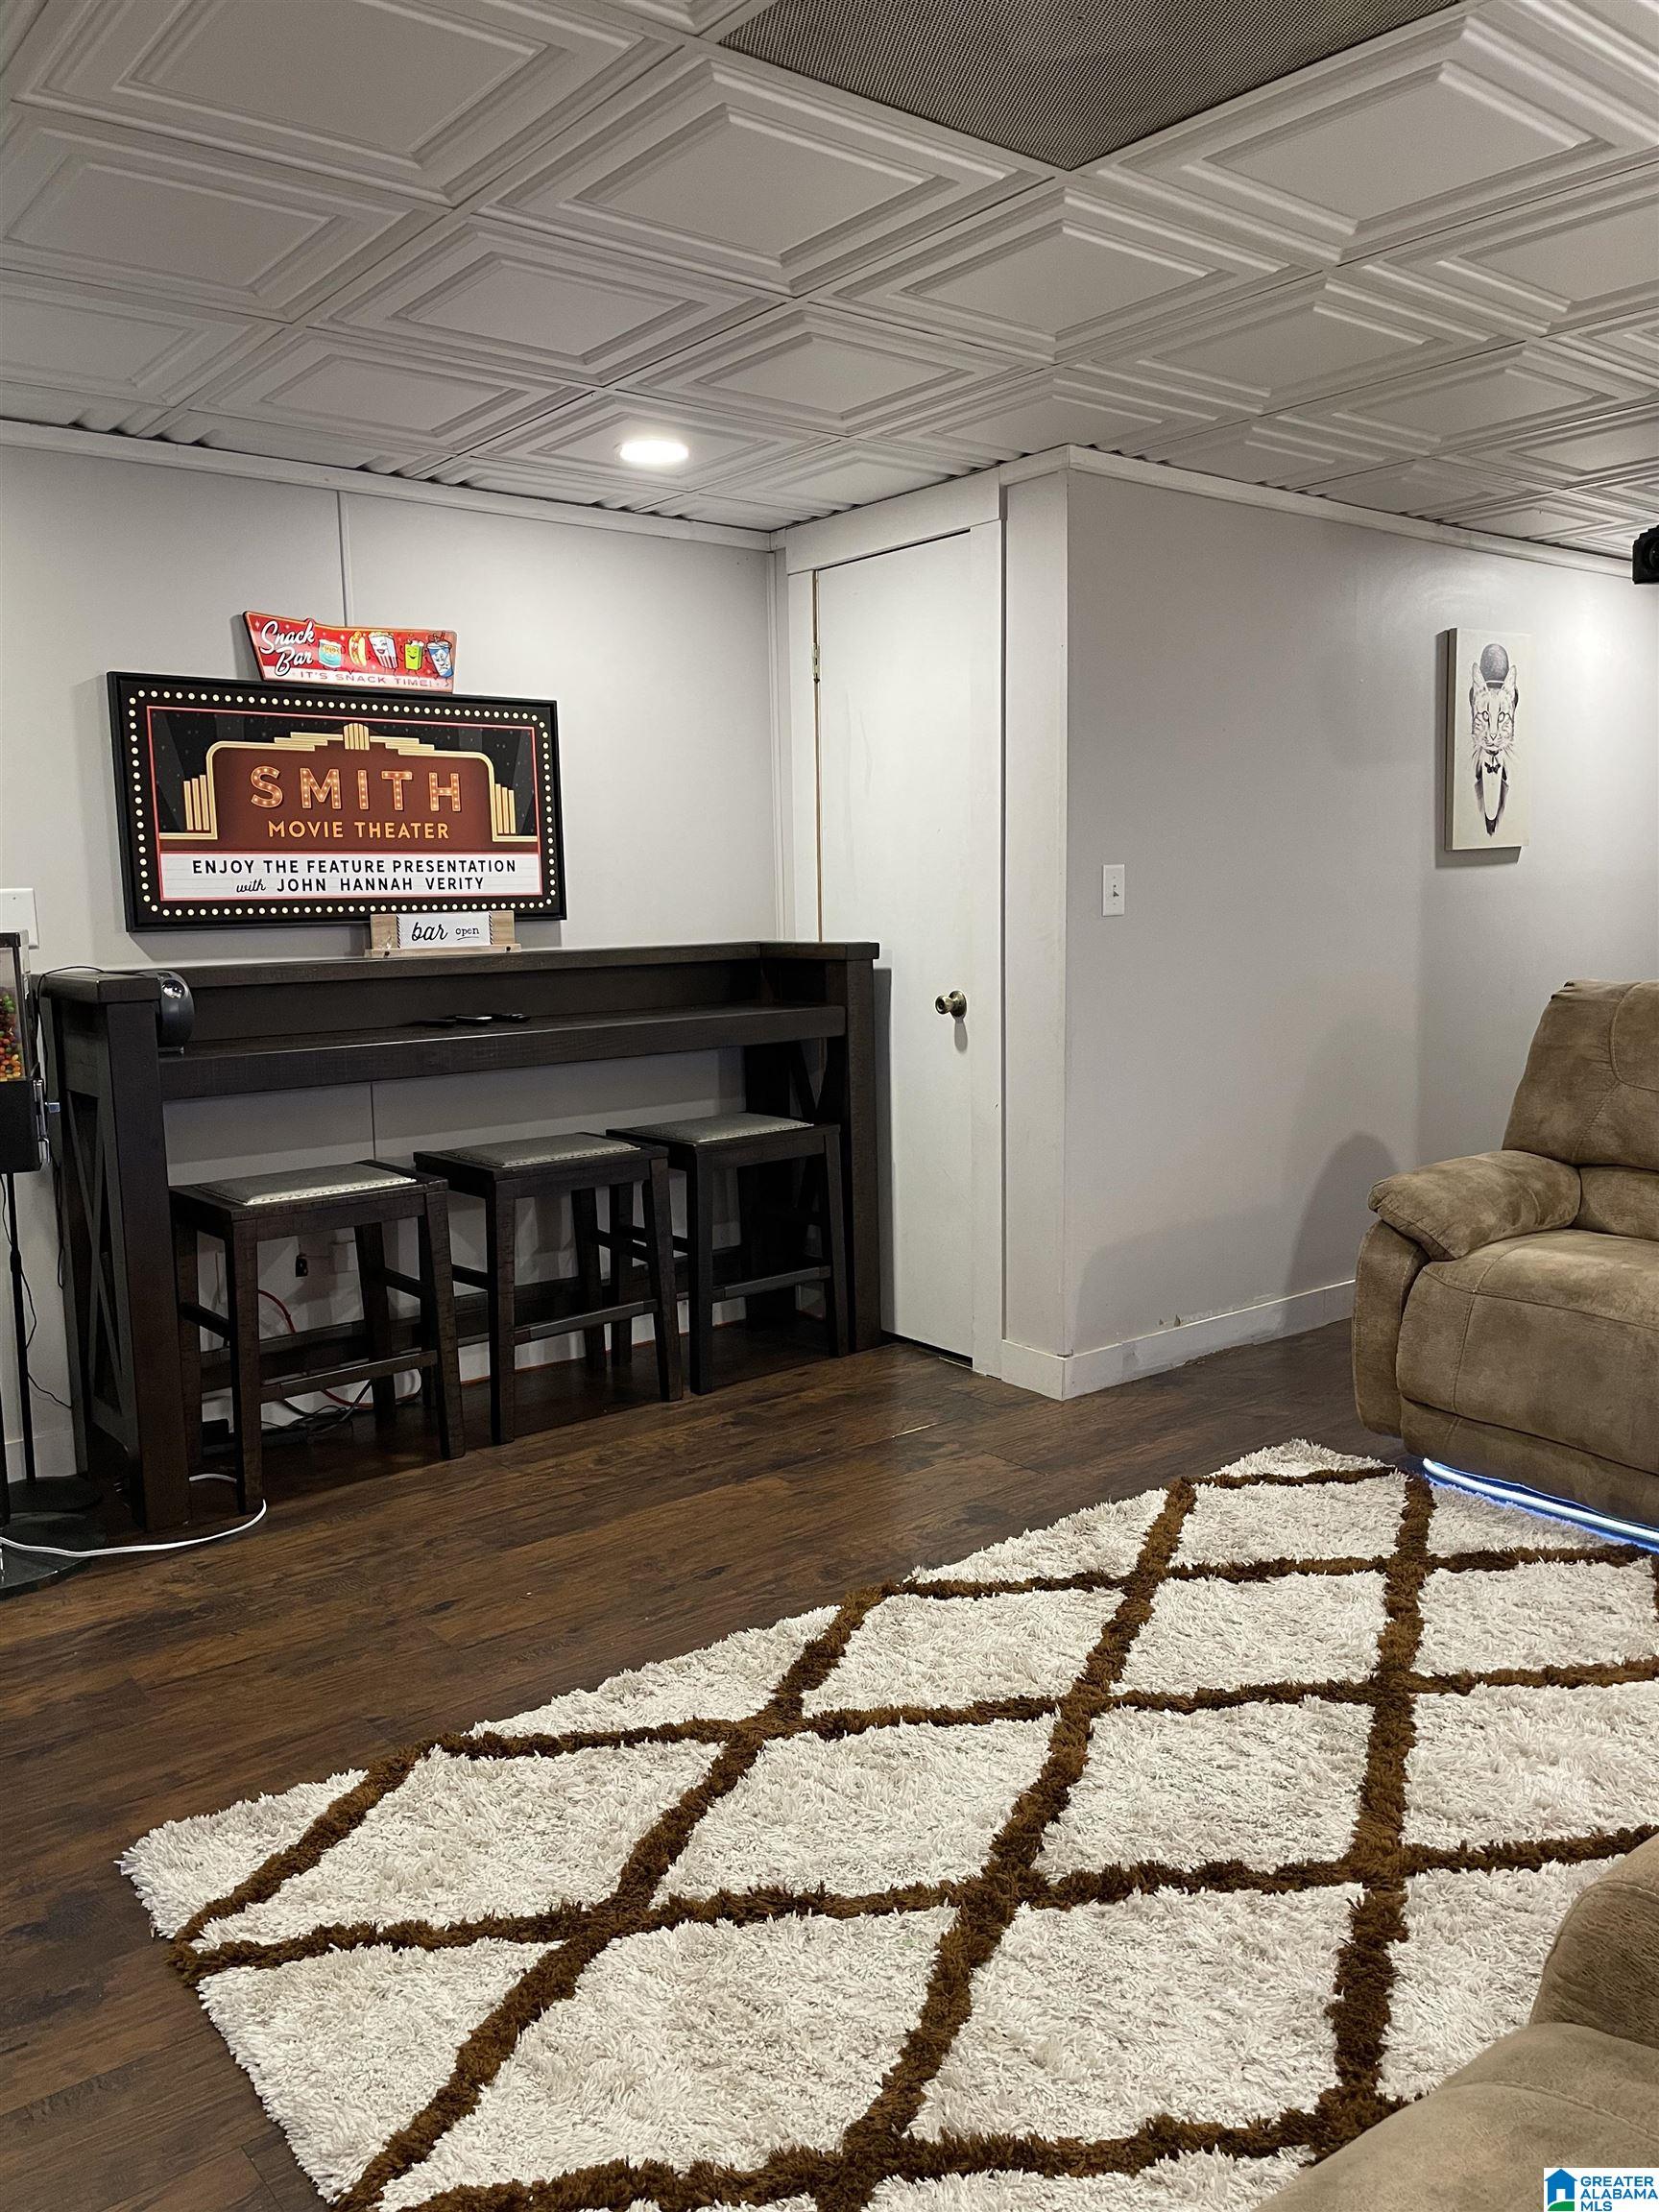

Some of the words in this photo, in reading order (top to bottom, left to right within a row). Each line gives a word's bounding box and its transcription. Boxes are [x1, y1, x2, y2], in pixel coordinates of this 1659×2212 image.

[259, 619, 315, 655] Snack
[275, 645, 313, 677] Bar
[301, 671, 328, 680] IT'S
[337, 673, 386, 684] SNACK
[395, 677, 433, 687] TIME!
[250, 765, 462, 812] SMITH
[268, 820, 345, 839] MOVIE
[354, 821, 449, 840] THEATER
[192, 859, 254, 875] ENJOY
[263, 859, 300, 874] THE
[307, 859, 385, 874] FEATURE
[393, 859, 516, 874] PRESENTATION
[236, 878, 267, 894] with
[276, 878, 326, 893] JOHN
[340, 878, 413, 892] HANNAH
[425, 877, 484, 891] VERITY
[411, 921, 448, 942] bar
[455, 926, 480, 937] open
